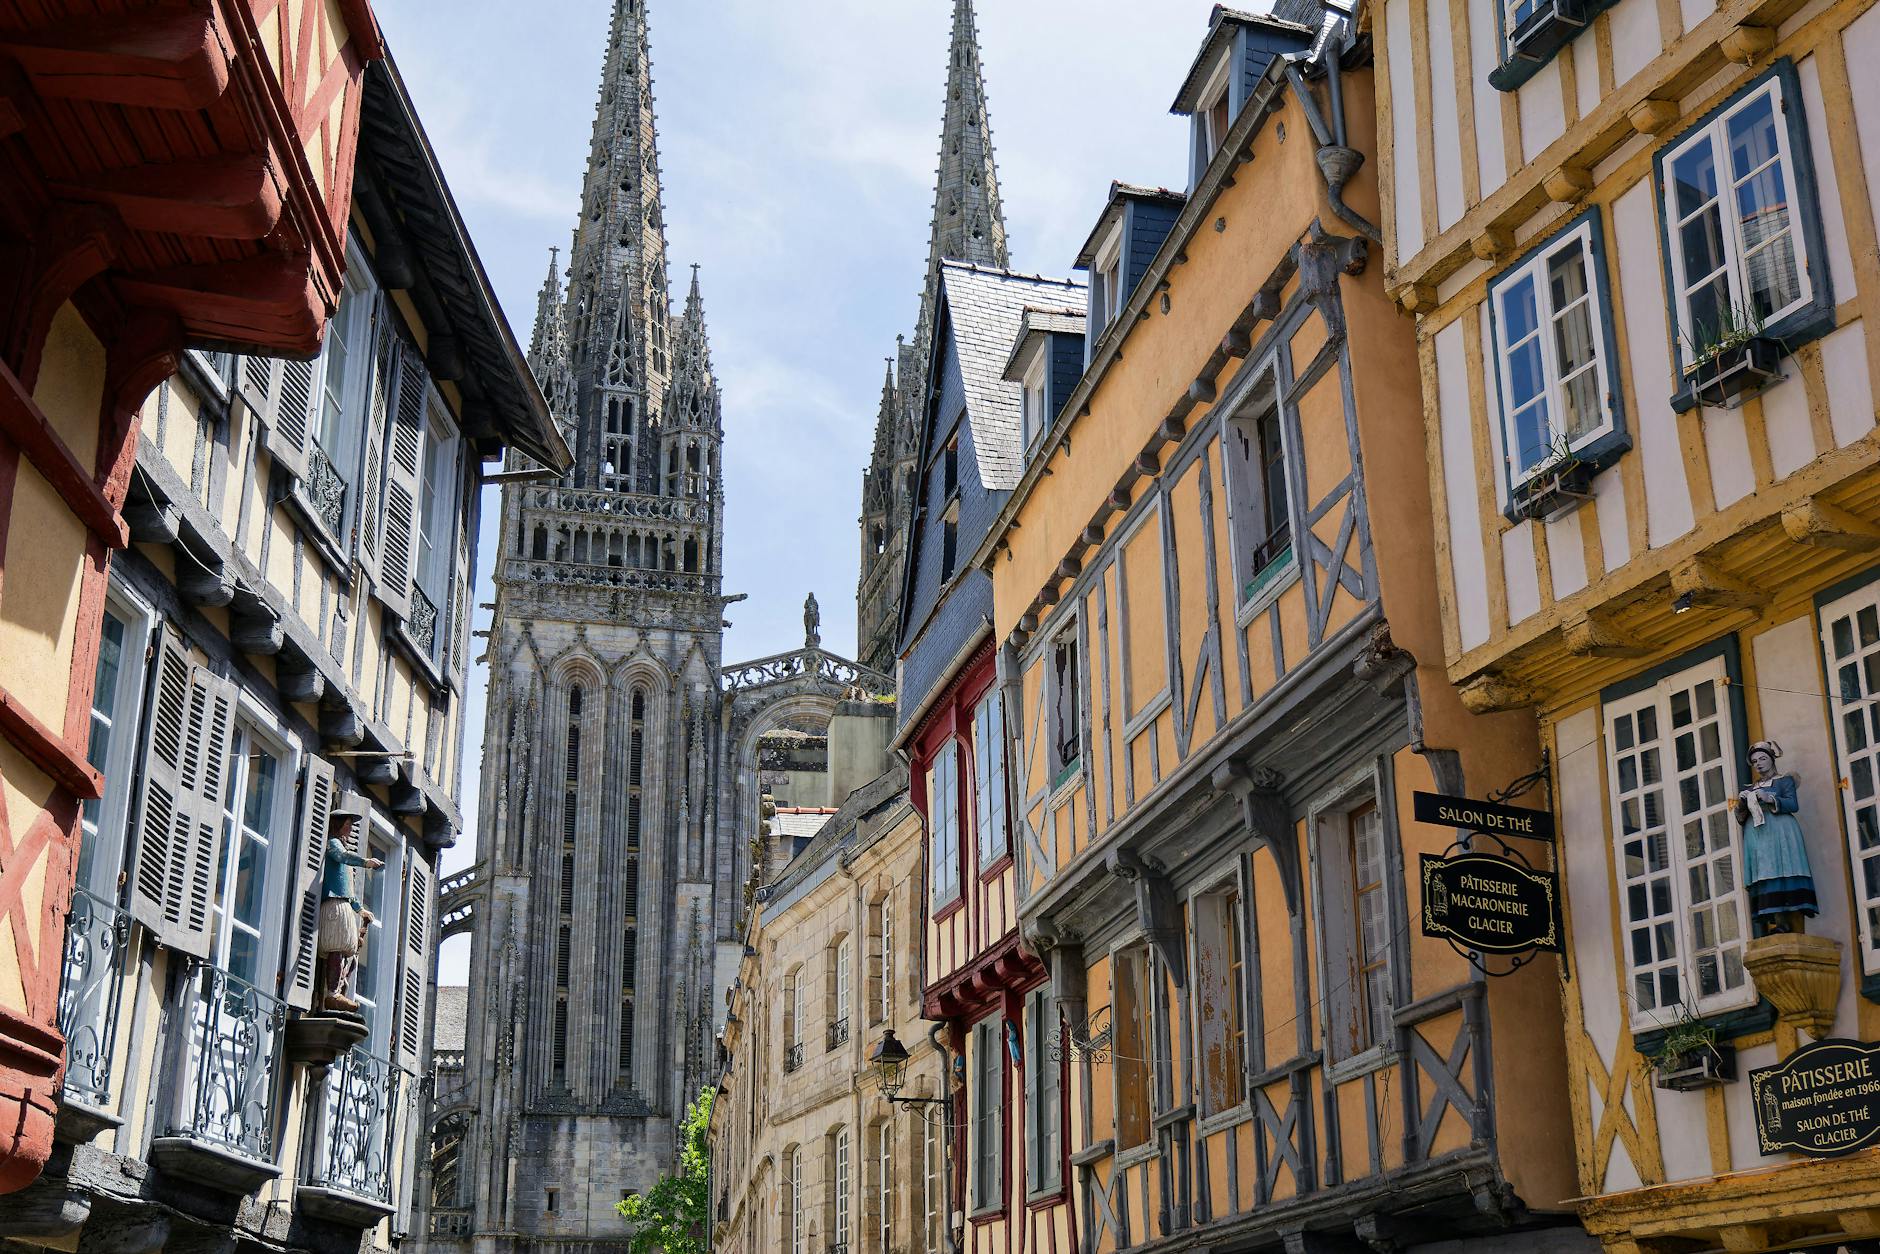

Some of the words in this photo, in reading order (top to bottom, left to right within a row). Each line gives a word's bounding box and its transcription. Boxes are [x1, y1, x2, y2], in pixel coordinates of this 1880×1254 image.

[1439, 806, 1483, 825] SALON
[1487, 814, 1505, 828] DE
[1507, 815, 1533, 832] THÉ
[1460, 874, 1518, 897] PÂTISSERIE
[1451, 893, 1529, 917] MACARONERIE
[1468, 916, 1514, 934] GLACIER
[1781, 1058, 1872, 1094] PÂTISSERIE
[1781, 1096, 1812, 1110] maison
[1813, 1088, 1843, 1106] fondée
[1844, 1087, 1857, 1097] en
[1857, 1080, 1880, 1096] 1966
[1796, 1115, 1831, 1133] SALON
[1832, 1111, 1847, 1126] DE
[1848, 1105, 1870, 1122] THÉ
[1813, 1128, 1858, 1146] GLACIER
